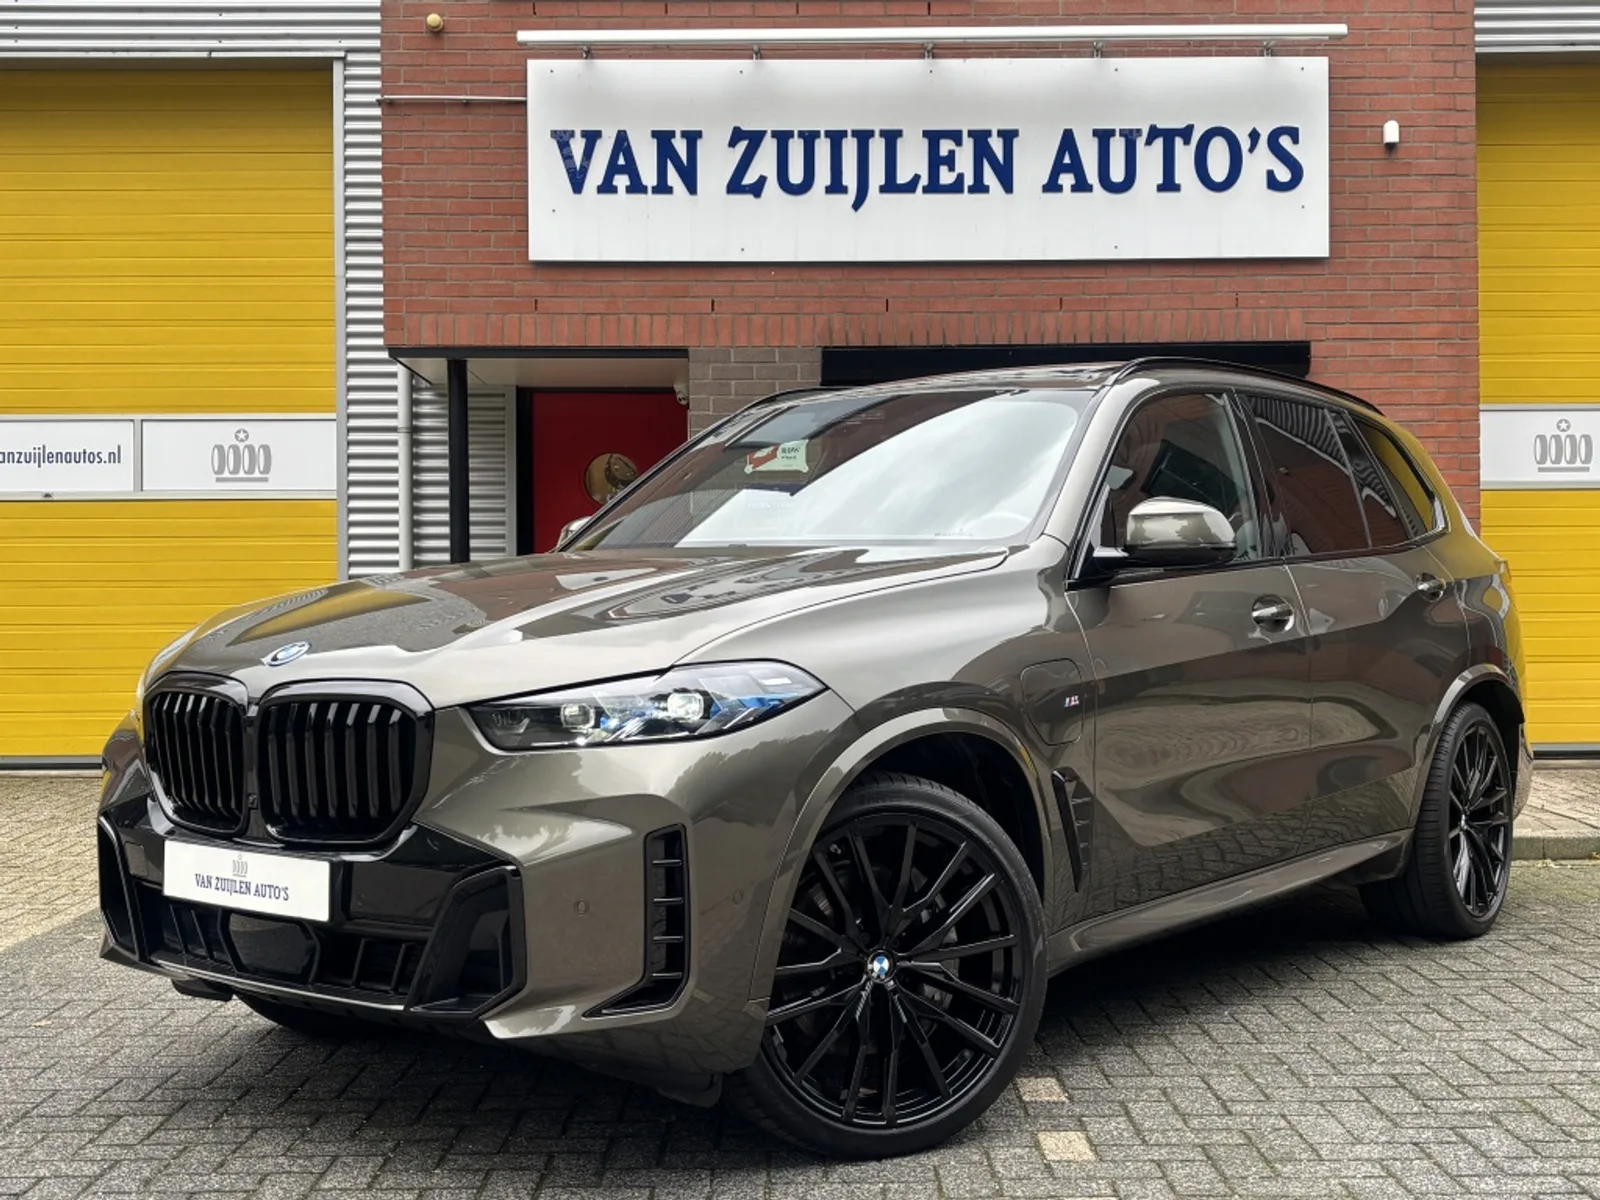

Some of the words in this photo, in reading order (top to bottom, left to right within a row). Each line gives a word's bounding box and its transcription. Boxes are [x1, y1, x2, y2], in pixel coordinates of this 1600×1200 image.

[551, 129, 703, 196] VAN
[726, 126, 1020, 213] ZUIJLEN
[1041, 123, 1304, 195] AUTO'S
[195, 873, 212, 889] VAN
[214, 876, 252, 896] ZUIJLEN
[253, 882, 290, 901] AUTO'S
